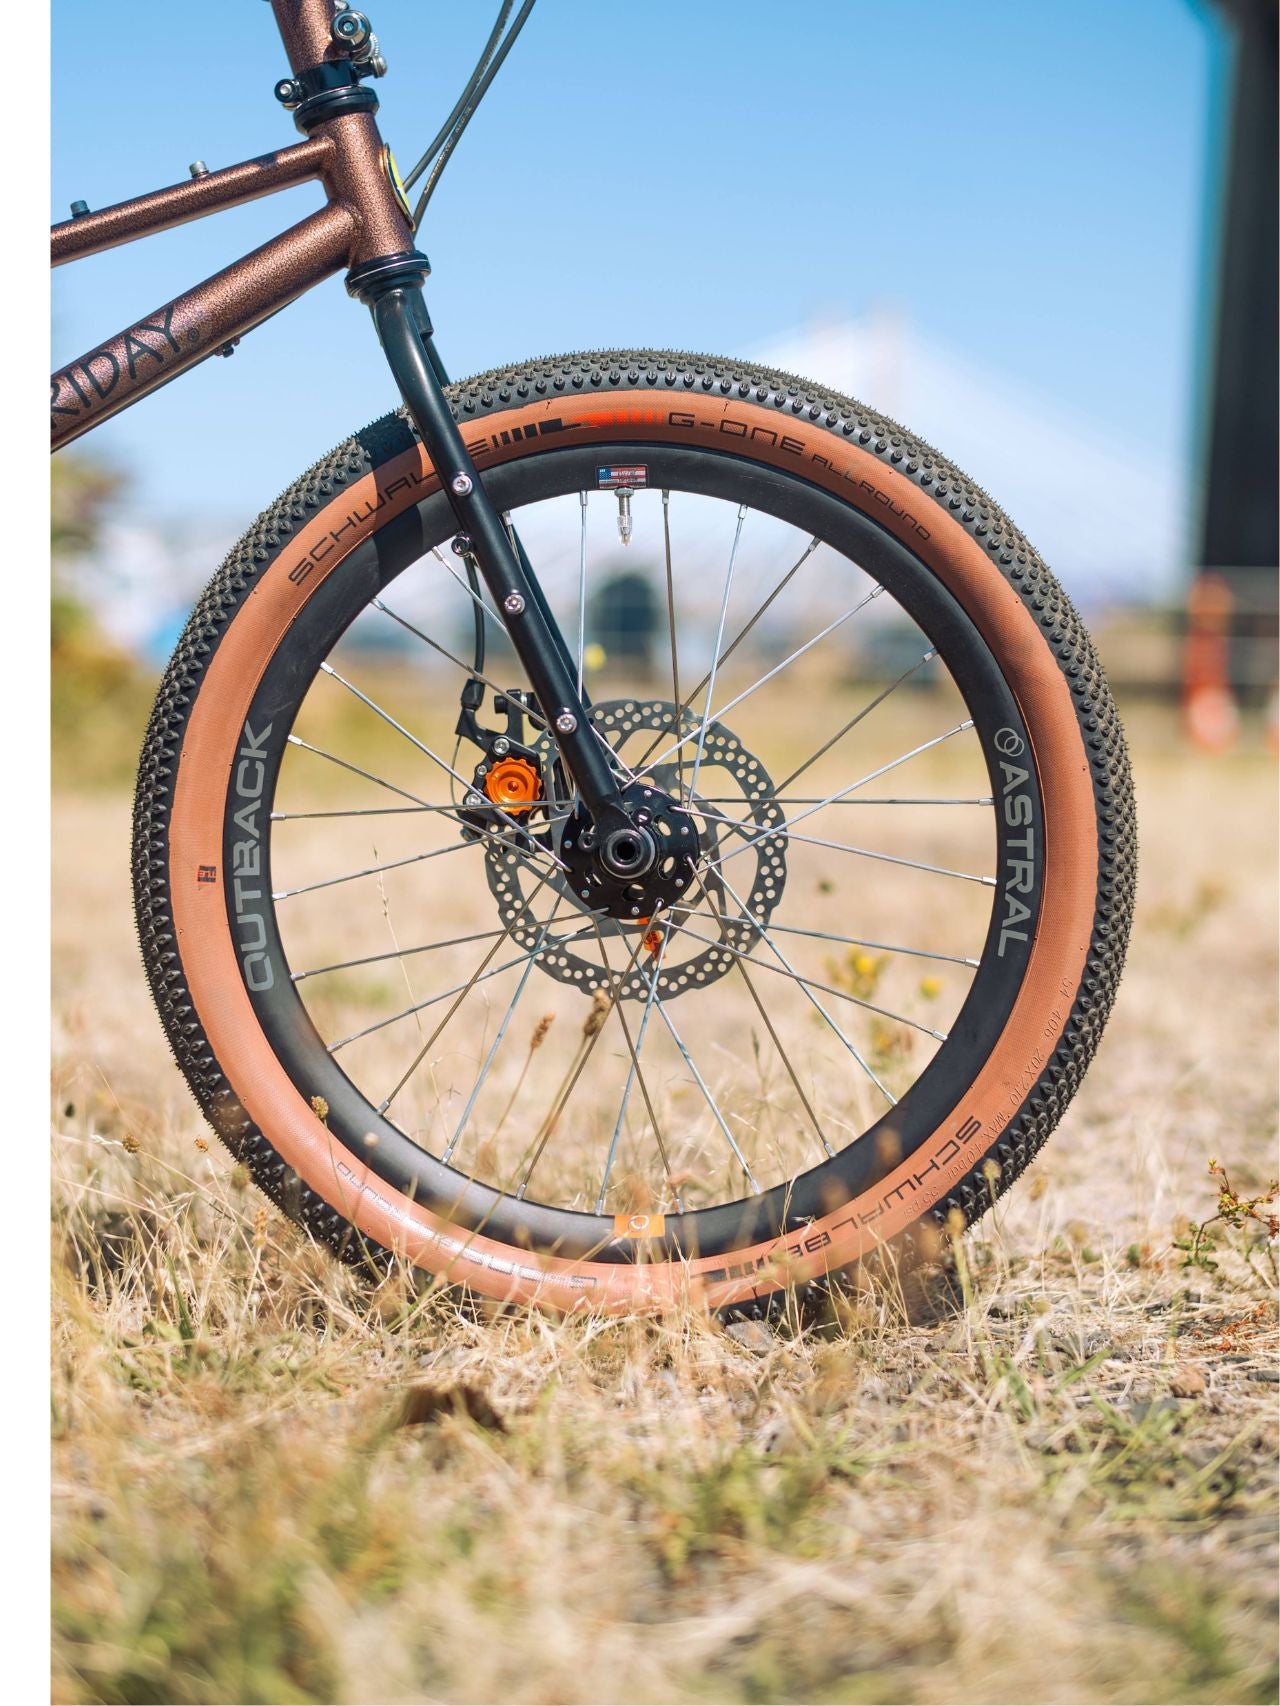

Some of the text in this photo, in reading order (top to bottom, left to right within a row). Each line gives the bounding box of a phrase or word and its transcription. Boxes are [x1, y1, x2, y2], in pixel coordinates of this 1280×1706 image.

[288, 438, 491, 586] SCHWALE
[668, 411, 931, 541] G-ONE ALLROUND
[233, 720, 275, 991] OUTBACK
[997, 760, 1035, 957] ASTRAL
